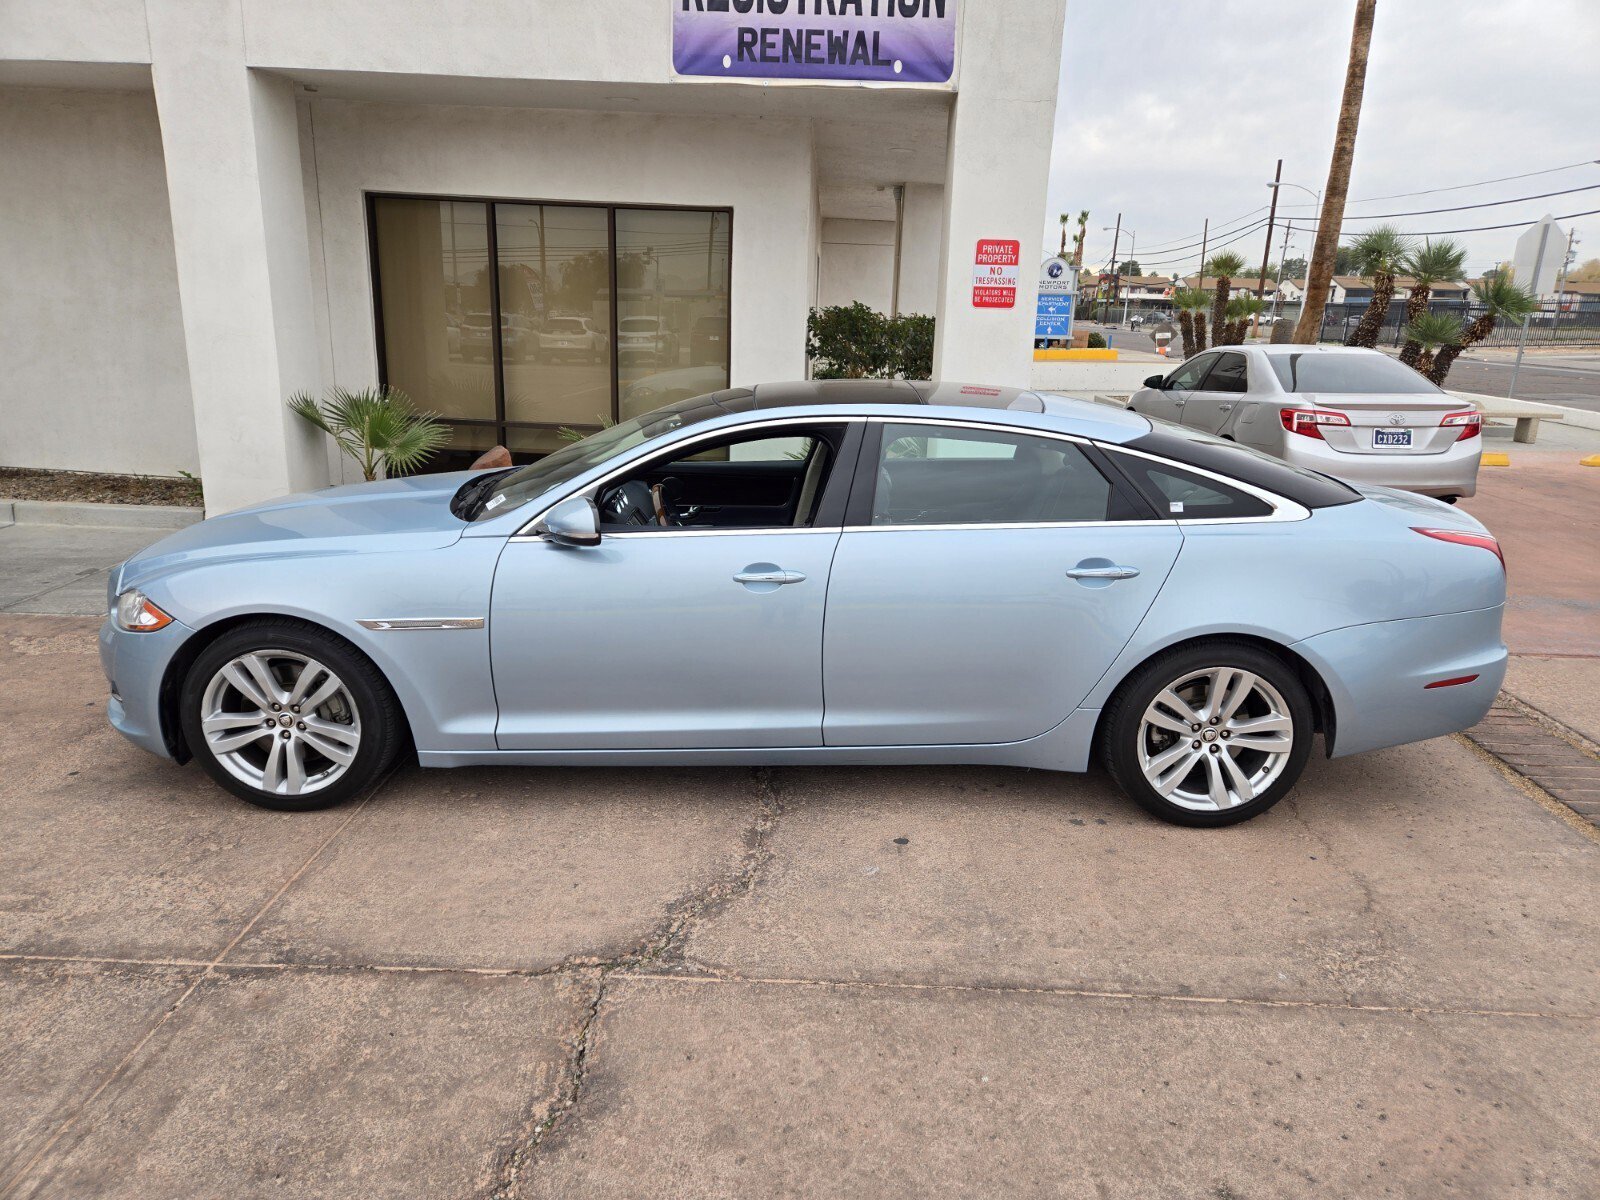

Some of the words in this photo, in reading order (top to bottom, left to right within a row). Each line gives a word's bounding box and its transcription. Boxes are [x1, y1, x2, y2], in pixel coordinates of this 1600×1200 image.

[737, 27, 892, 67] RENEWAL
[982, 245, 1014, 254] PRIVATE
[977, 254, 1017, 263] PROPERTY
[989, 267, 1003, 276] NO
[975, 277, 1016, 286] TRESPASSING
[1377, 434, 1409, 444] CXD232
